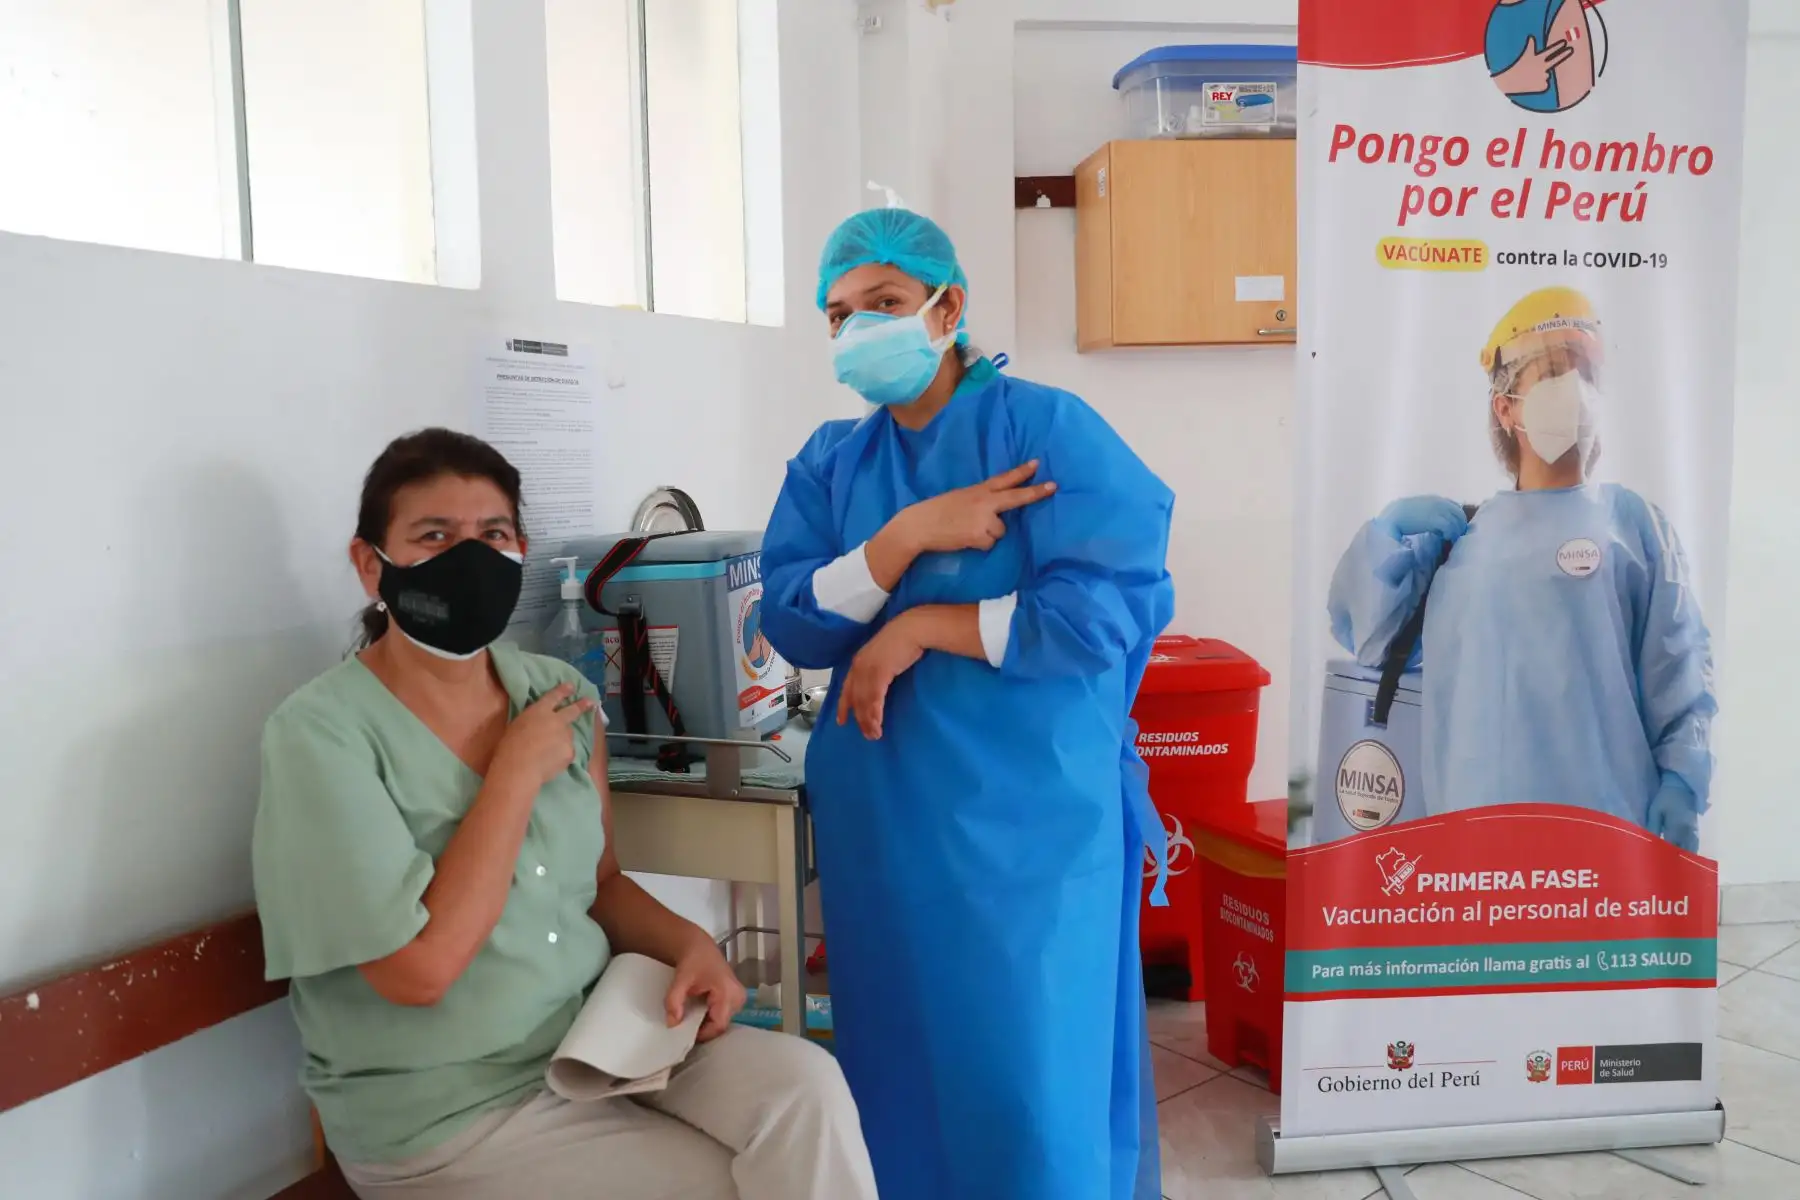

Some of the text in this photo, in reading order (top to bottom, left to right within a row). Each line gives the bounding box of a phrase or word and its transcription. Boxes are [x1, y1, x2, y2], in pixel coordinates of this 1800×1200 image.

[1212, 92, 1233, 101] REY
[1328, 124, 1715, 178] Pongo el hombro
[1397, 178, 1650, 227] por el Perú
[1383, 241, 1668, 269] VACÚNATE contra la COVID-19
[1559, 549, 1599, 560] MINSA
[729, 555, 761, 588] MINS
[1139, 732, 1199, 742] RESIDUOS
[1136, 744, 1229, 756] ONTAMINADOS
[1340, 768, 1399, 798] MINSA
[1417, 868, 1599, 893] PRIMERA FASE:
[1223, 893, 1270, 926] RESIDUOS
[1322, 895, 1689, 927] Vacunación al personal de salud
[1312, 951, 1692, 979] Para más información llama gratis al 113 SALUD
[1561, 1057, 1590, 1072] PERÚ
[1600, 1058, 1641, 1068] Ministerio
[1600, 1068, 1635, 1077] de Salud
[1317, 1069, 1481, 1094] Gobierno del Perú
